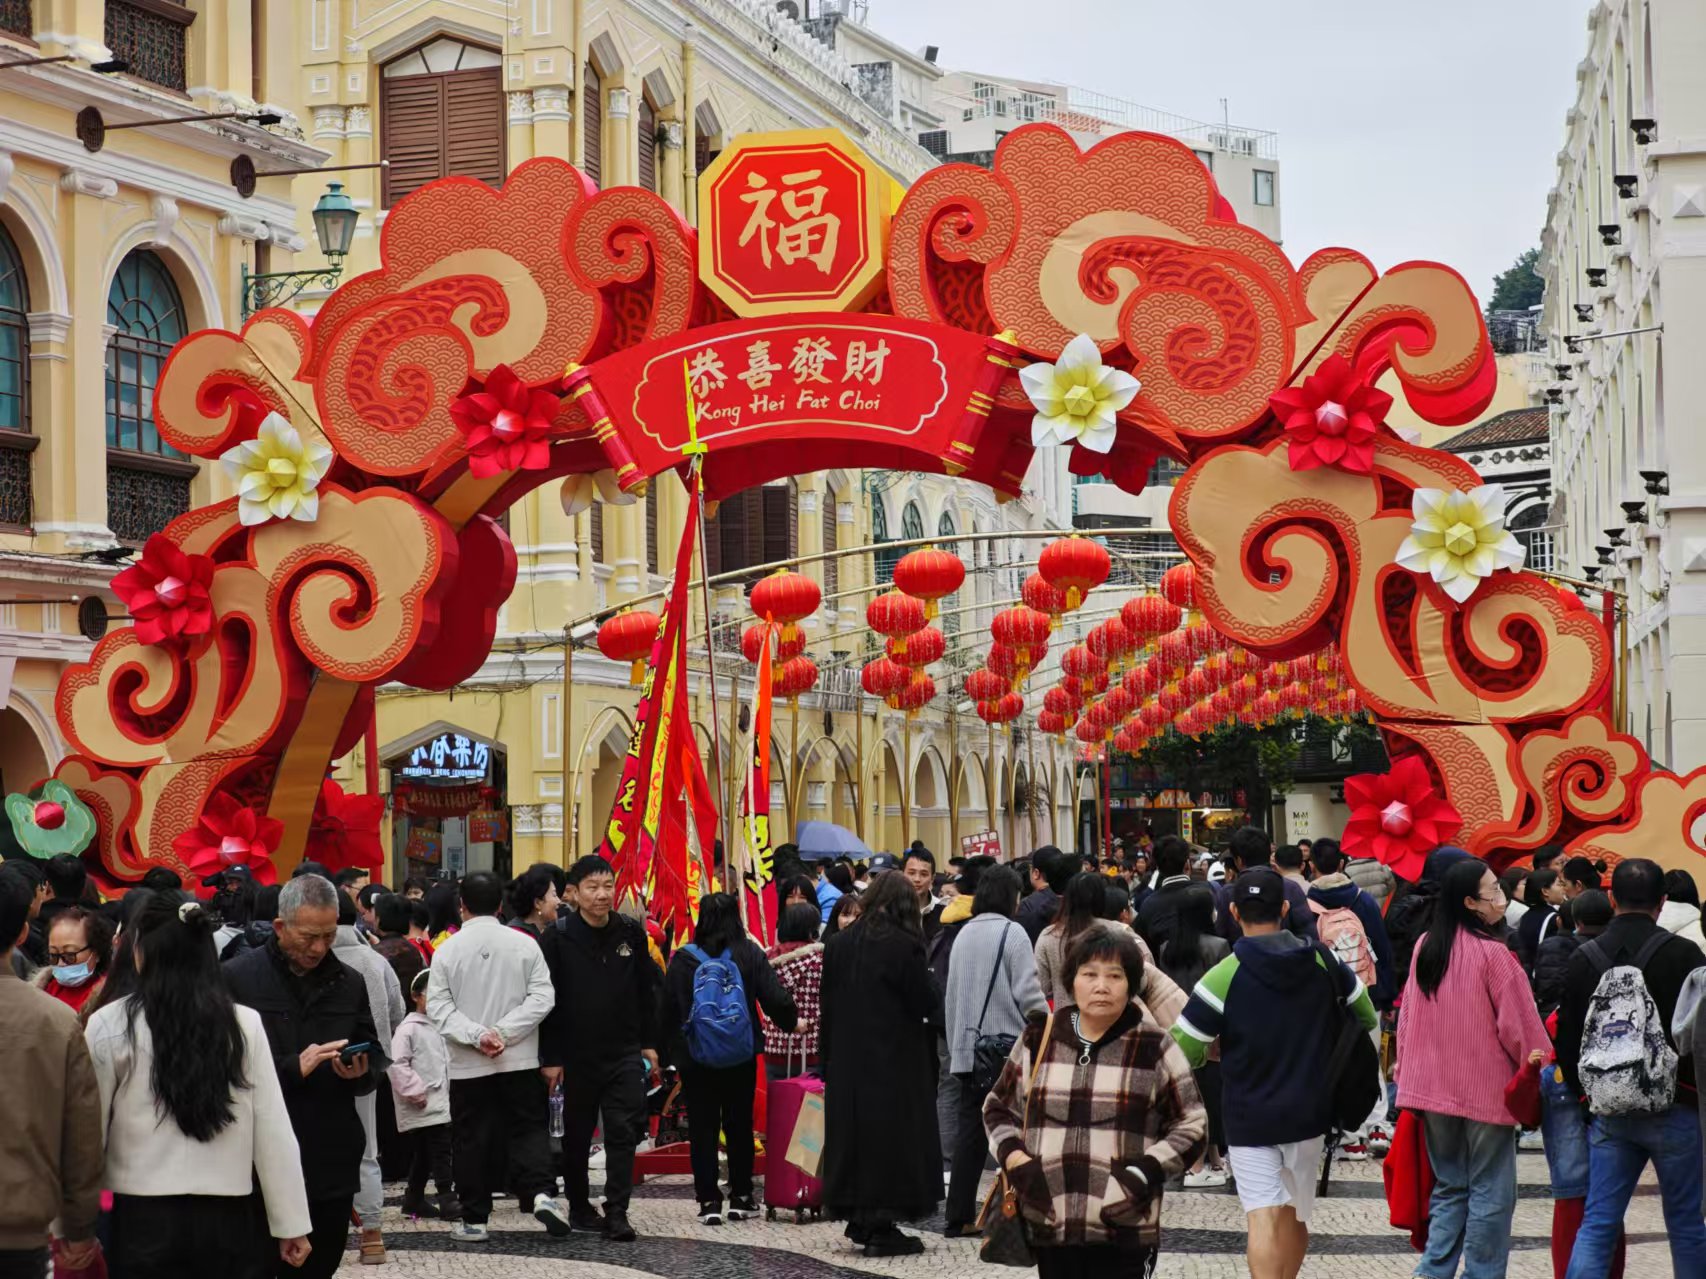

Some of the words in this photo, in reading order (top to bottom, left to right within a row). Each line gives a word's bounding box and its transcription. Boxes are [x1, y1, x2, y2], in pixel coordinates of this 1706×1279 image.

[738, 169, 841, 275] 福
[690, 336, 891, 399] 恭喜發財
[695, 402, 741, 426] Kong
[749, 394, 785, 414] Hei
[796, 389, 830, 409] Fat
[838, 390, 881, 410] Choi
